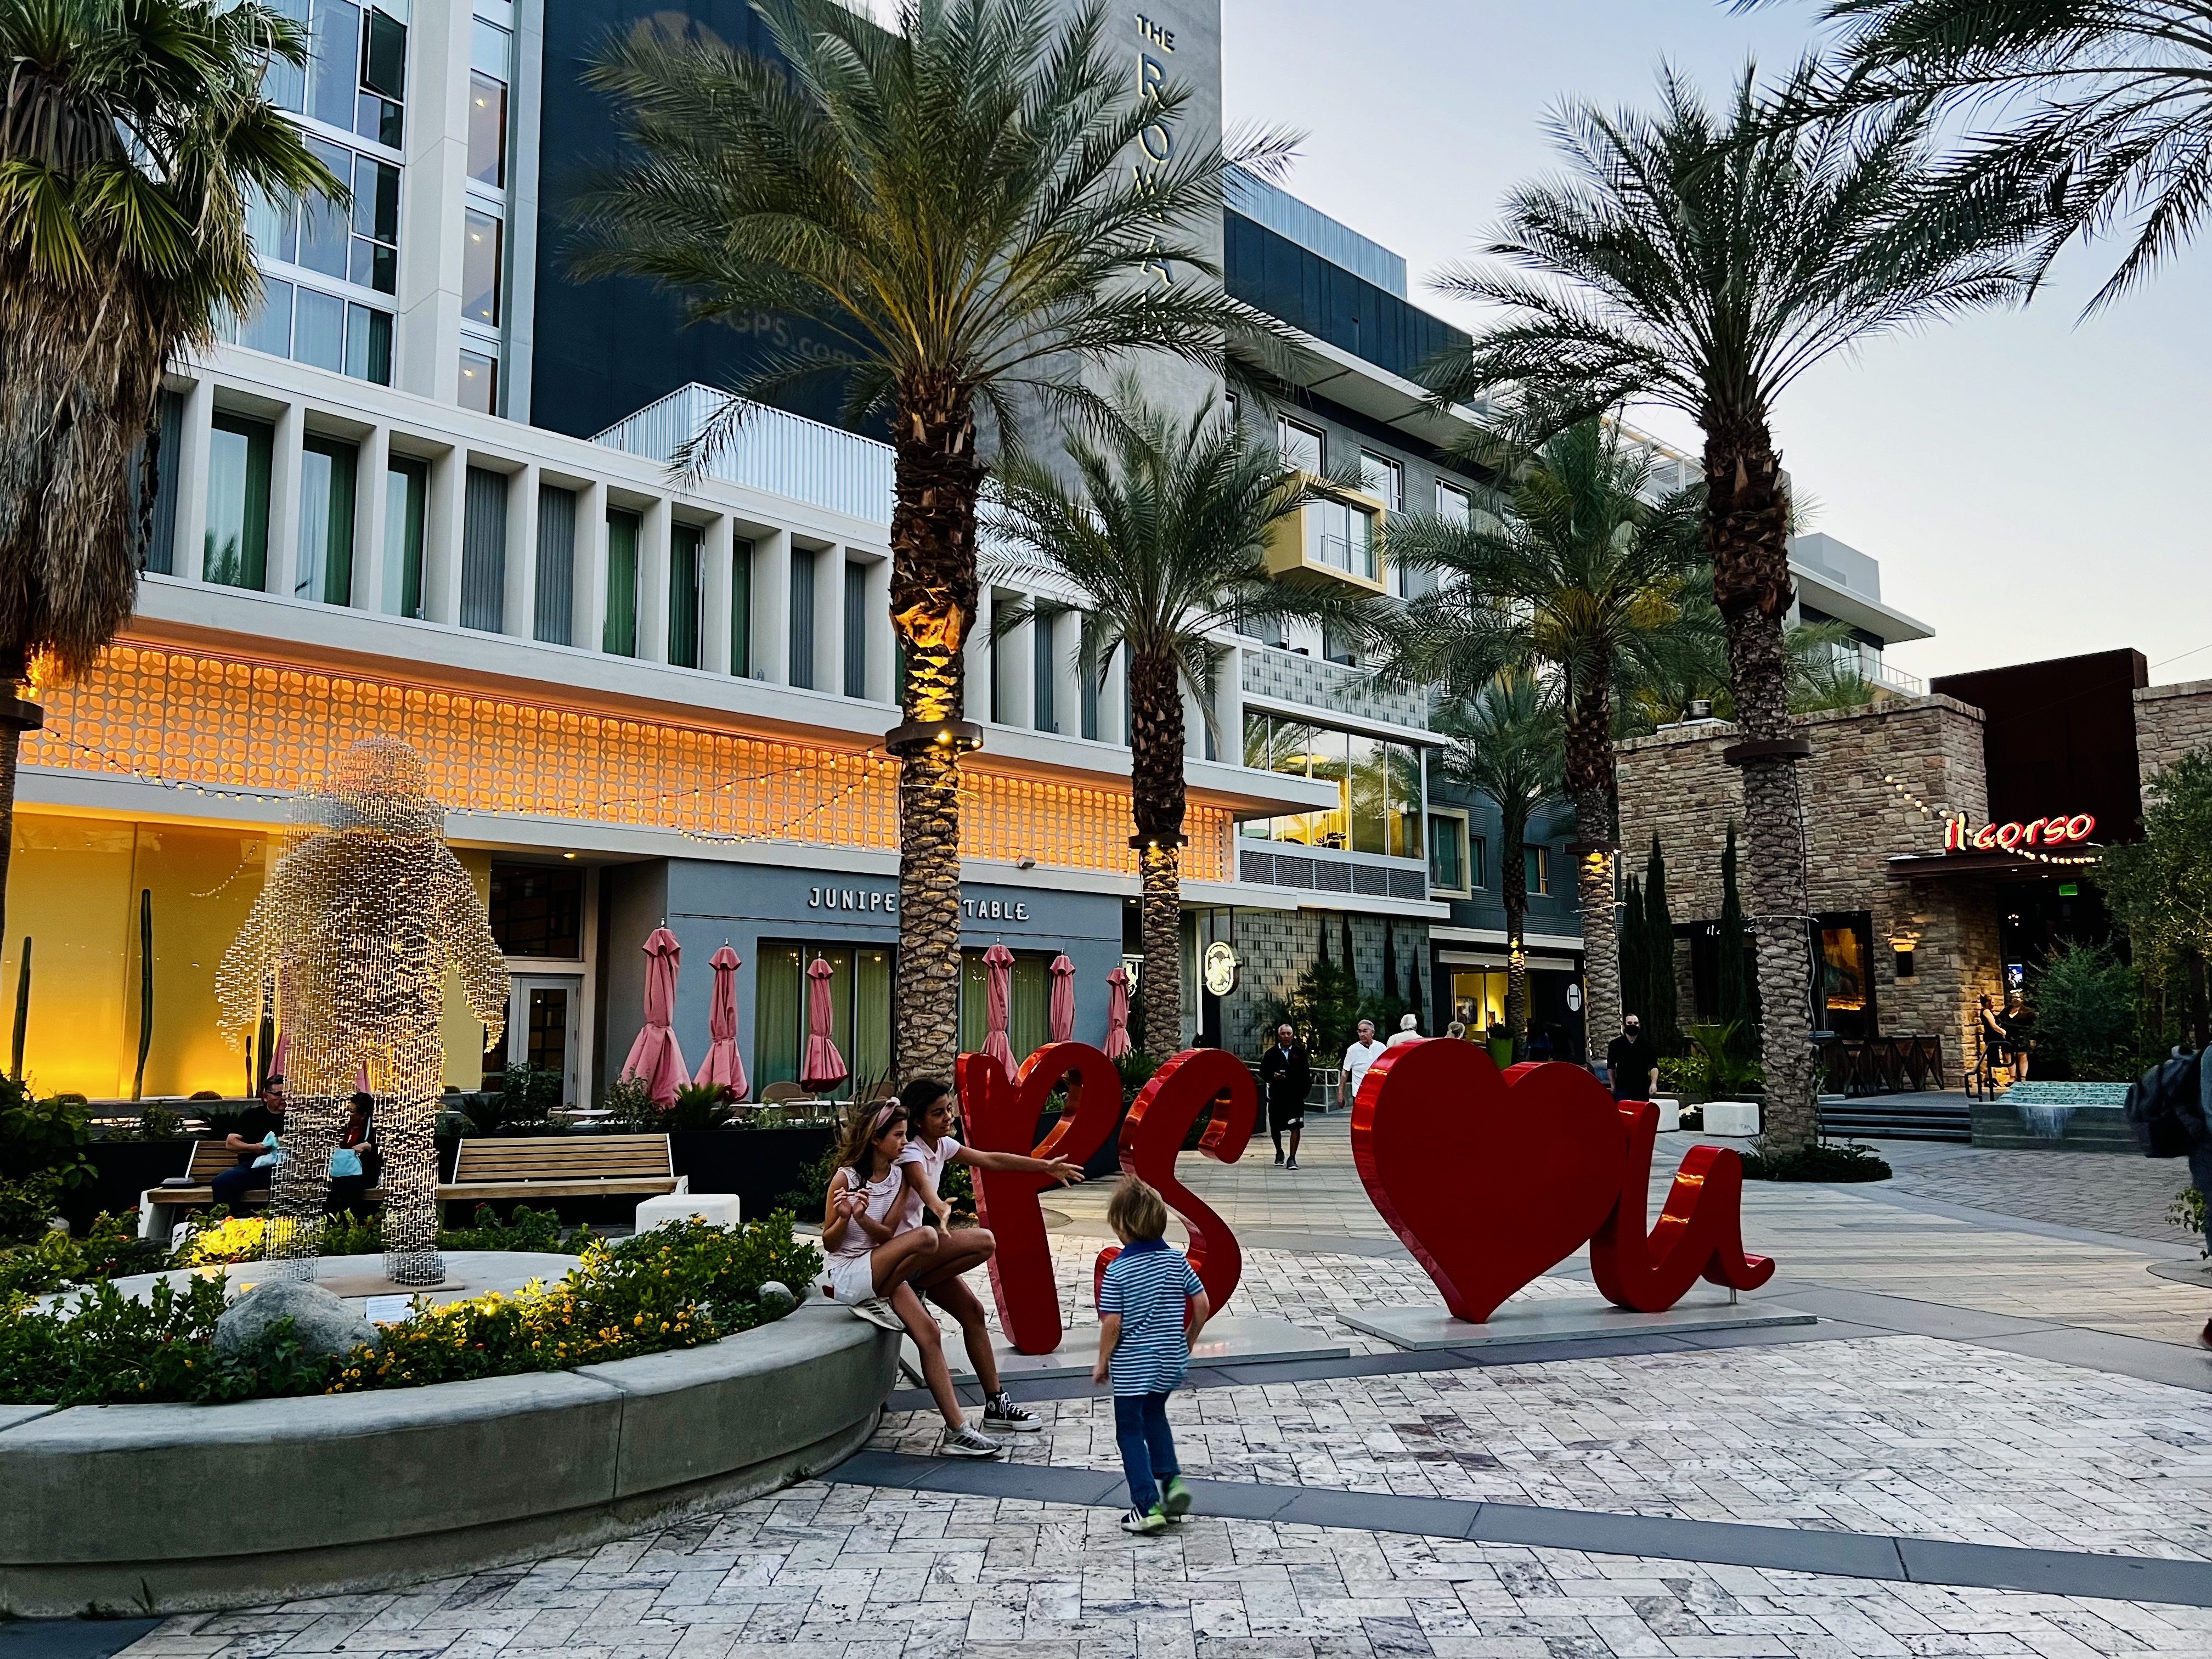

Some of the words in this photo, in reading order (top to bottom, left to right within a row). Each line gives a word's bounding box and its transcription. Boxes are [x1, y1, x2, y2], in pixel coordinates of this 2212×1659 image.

[1134, 13, 1175, 53] THE
[809, 888, 896, 912] JUNIPE
[963, 899, 1029, 920] TABLE
[1568, 987, 1580, 1007] H
